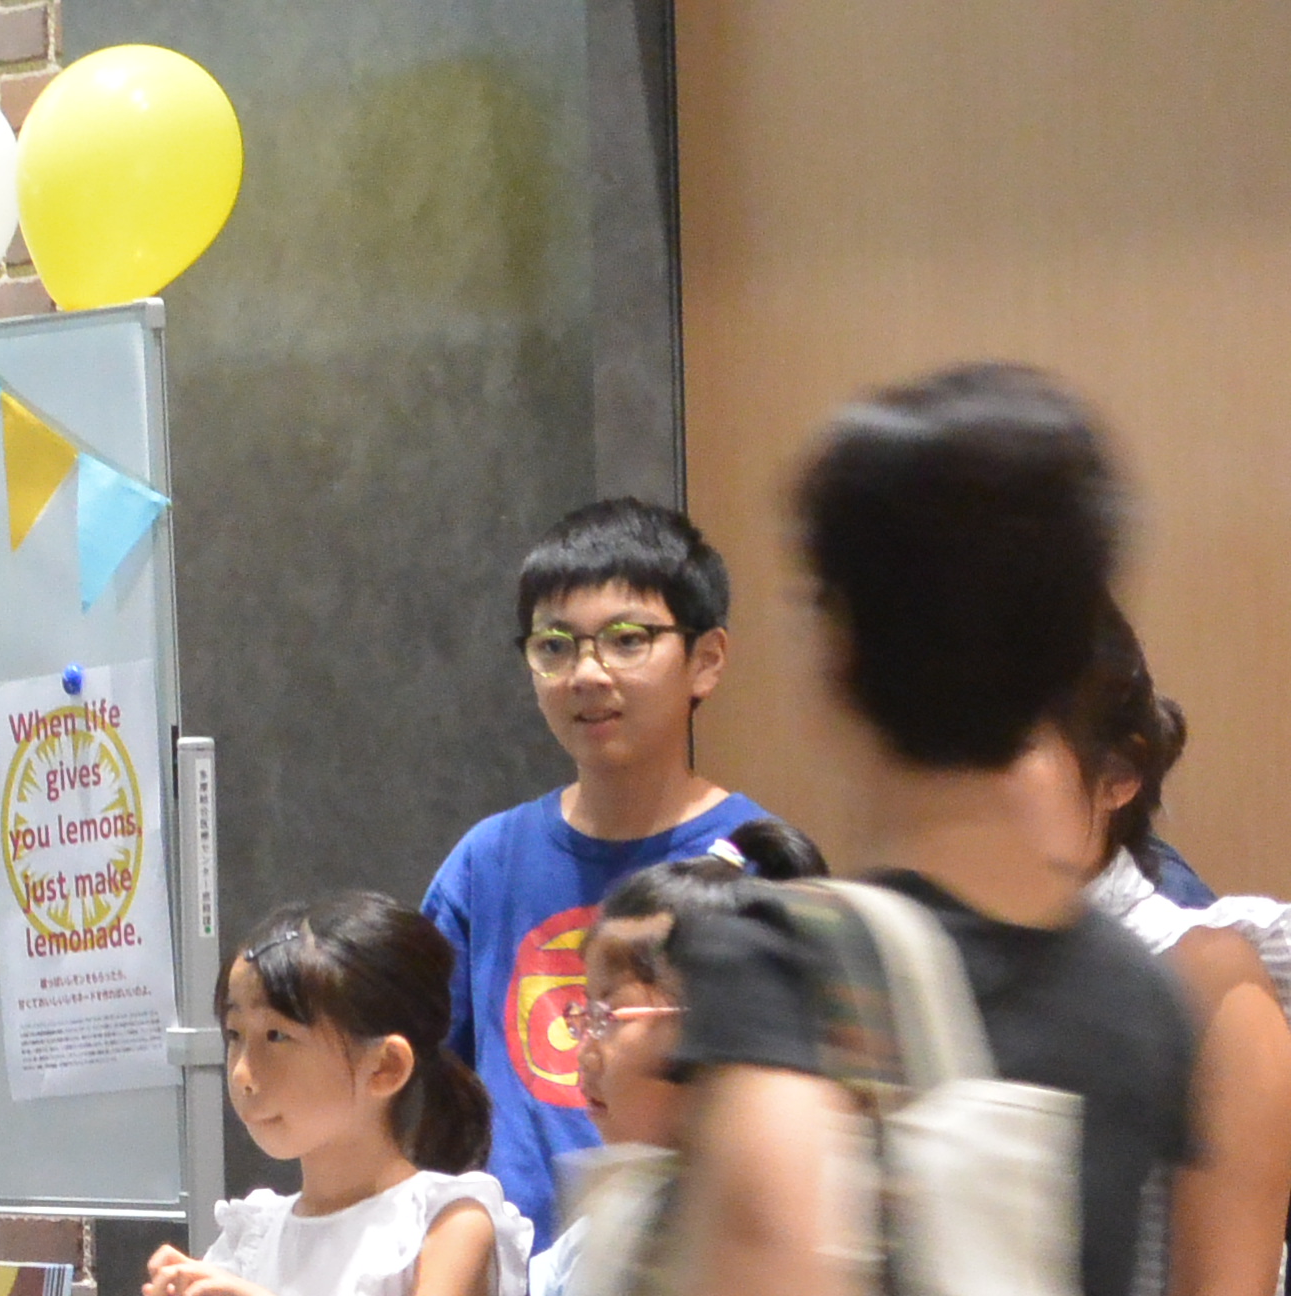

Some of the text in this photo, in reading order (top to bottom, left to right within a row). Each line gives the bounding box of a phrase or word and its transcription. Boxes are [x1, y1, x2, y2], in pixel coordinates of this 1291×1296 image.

[9, 699, 122, 744] When life
[45, 761, 103, 802] gives
[9, 810, 144, 862] you lemons,
[21, 864, 132, 914] just make
[25, 917, 143, 960] lemonade.
